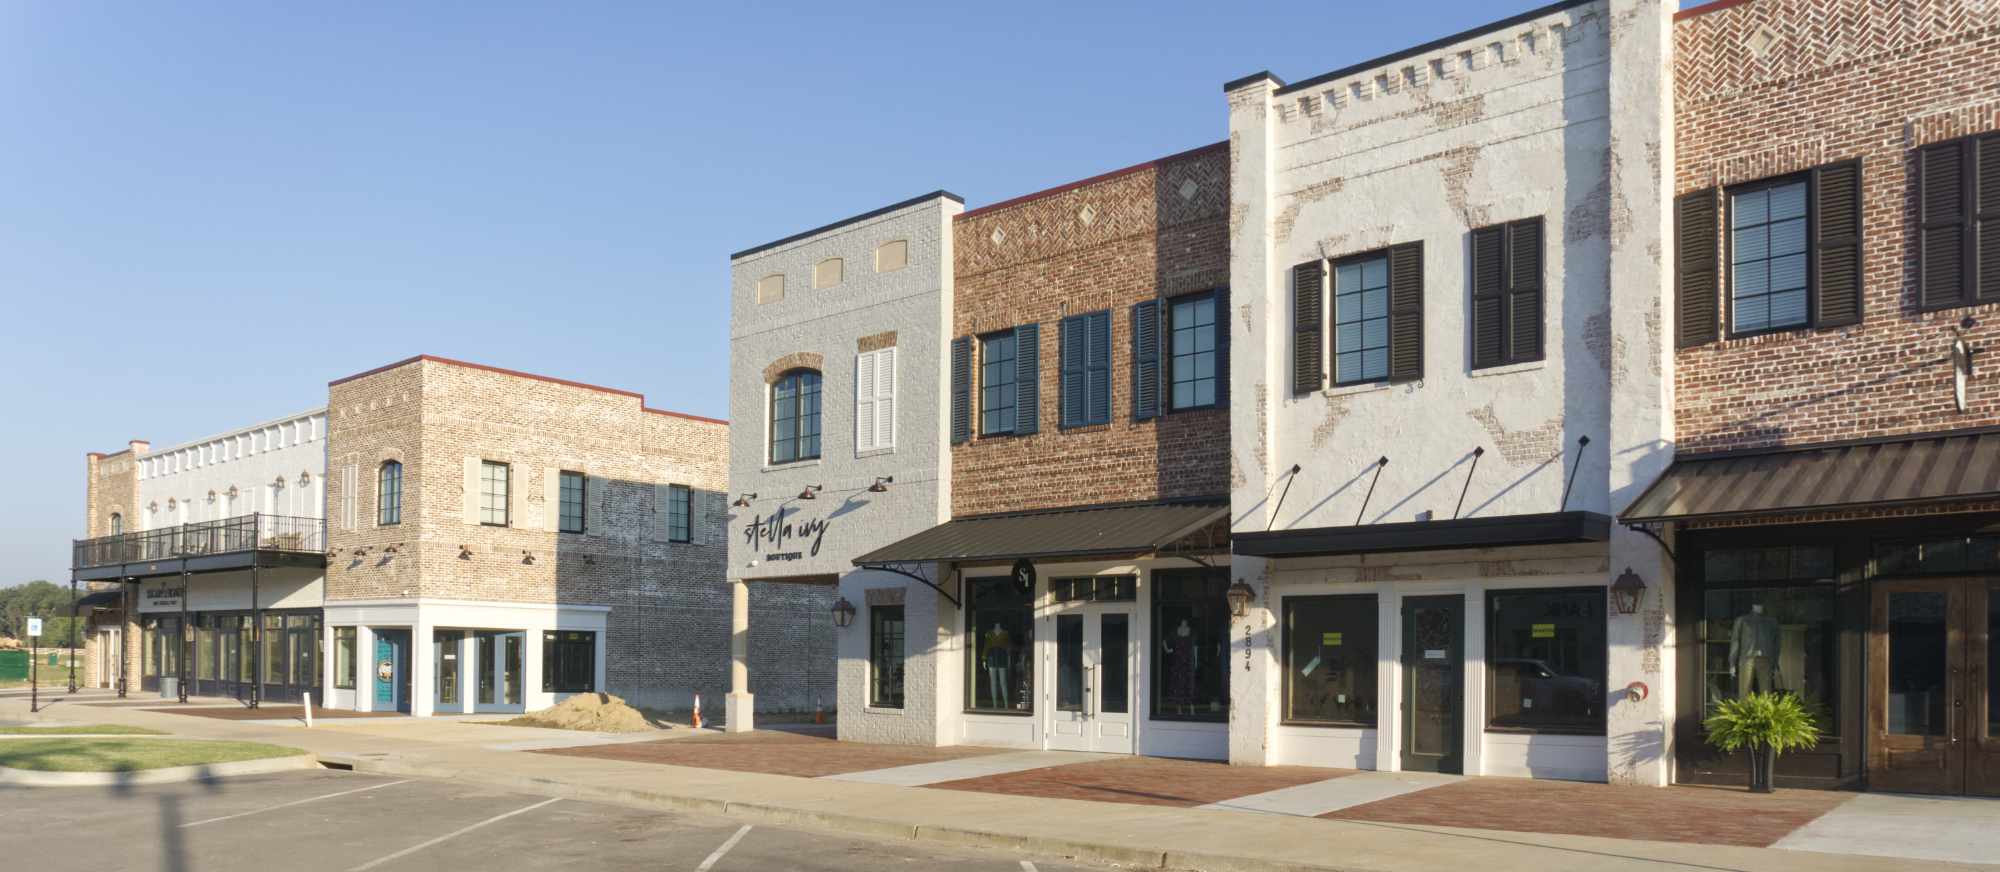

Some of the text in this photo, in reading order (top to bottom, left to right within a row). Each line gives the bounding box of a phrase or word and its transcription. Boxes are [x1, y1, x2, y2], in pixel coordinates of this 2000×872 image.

[744, 507, 830, 557] stella ivy
[766, 552, 802, 561] BOUTIQUE
